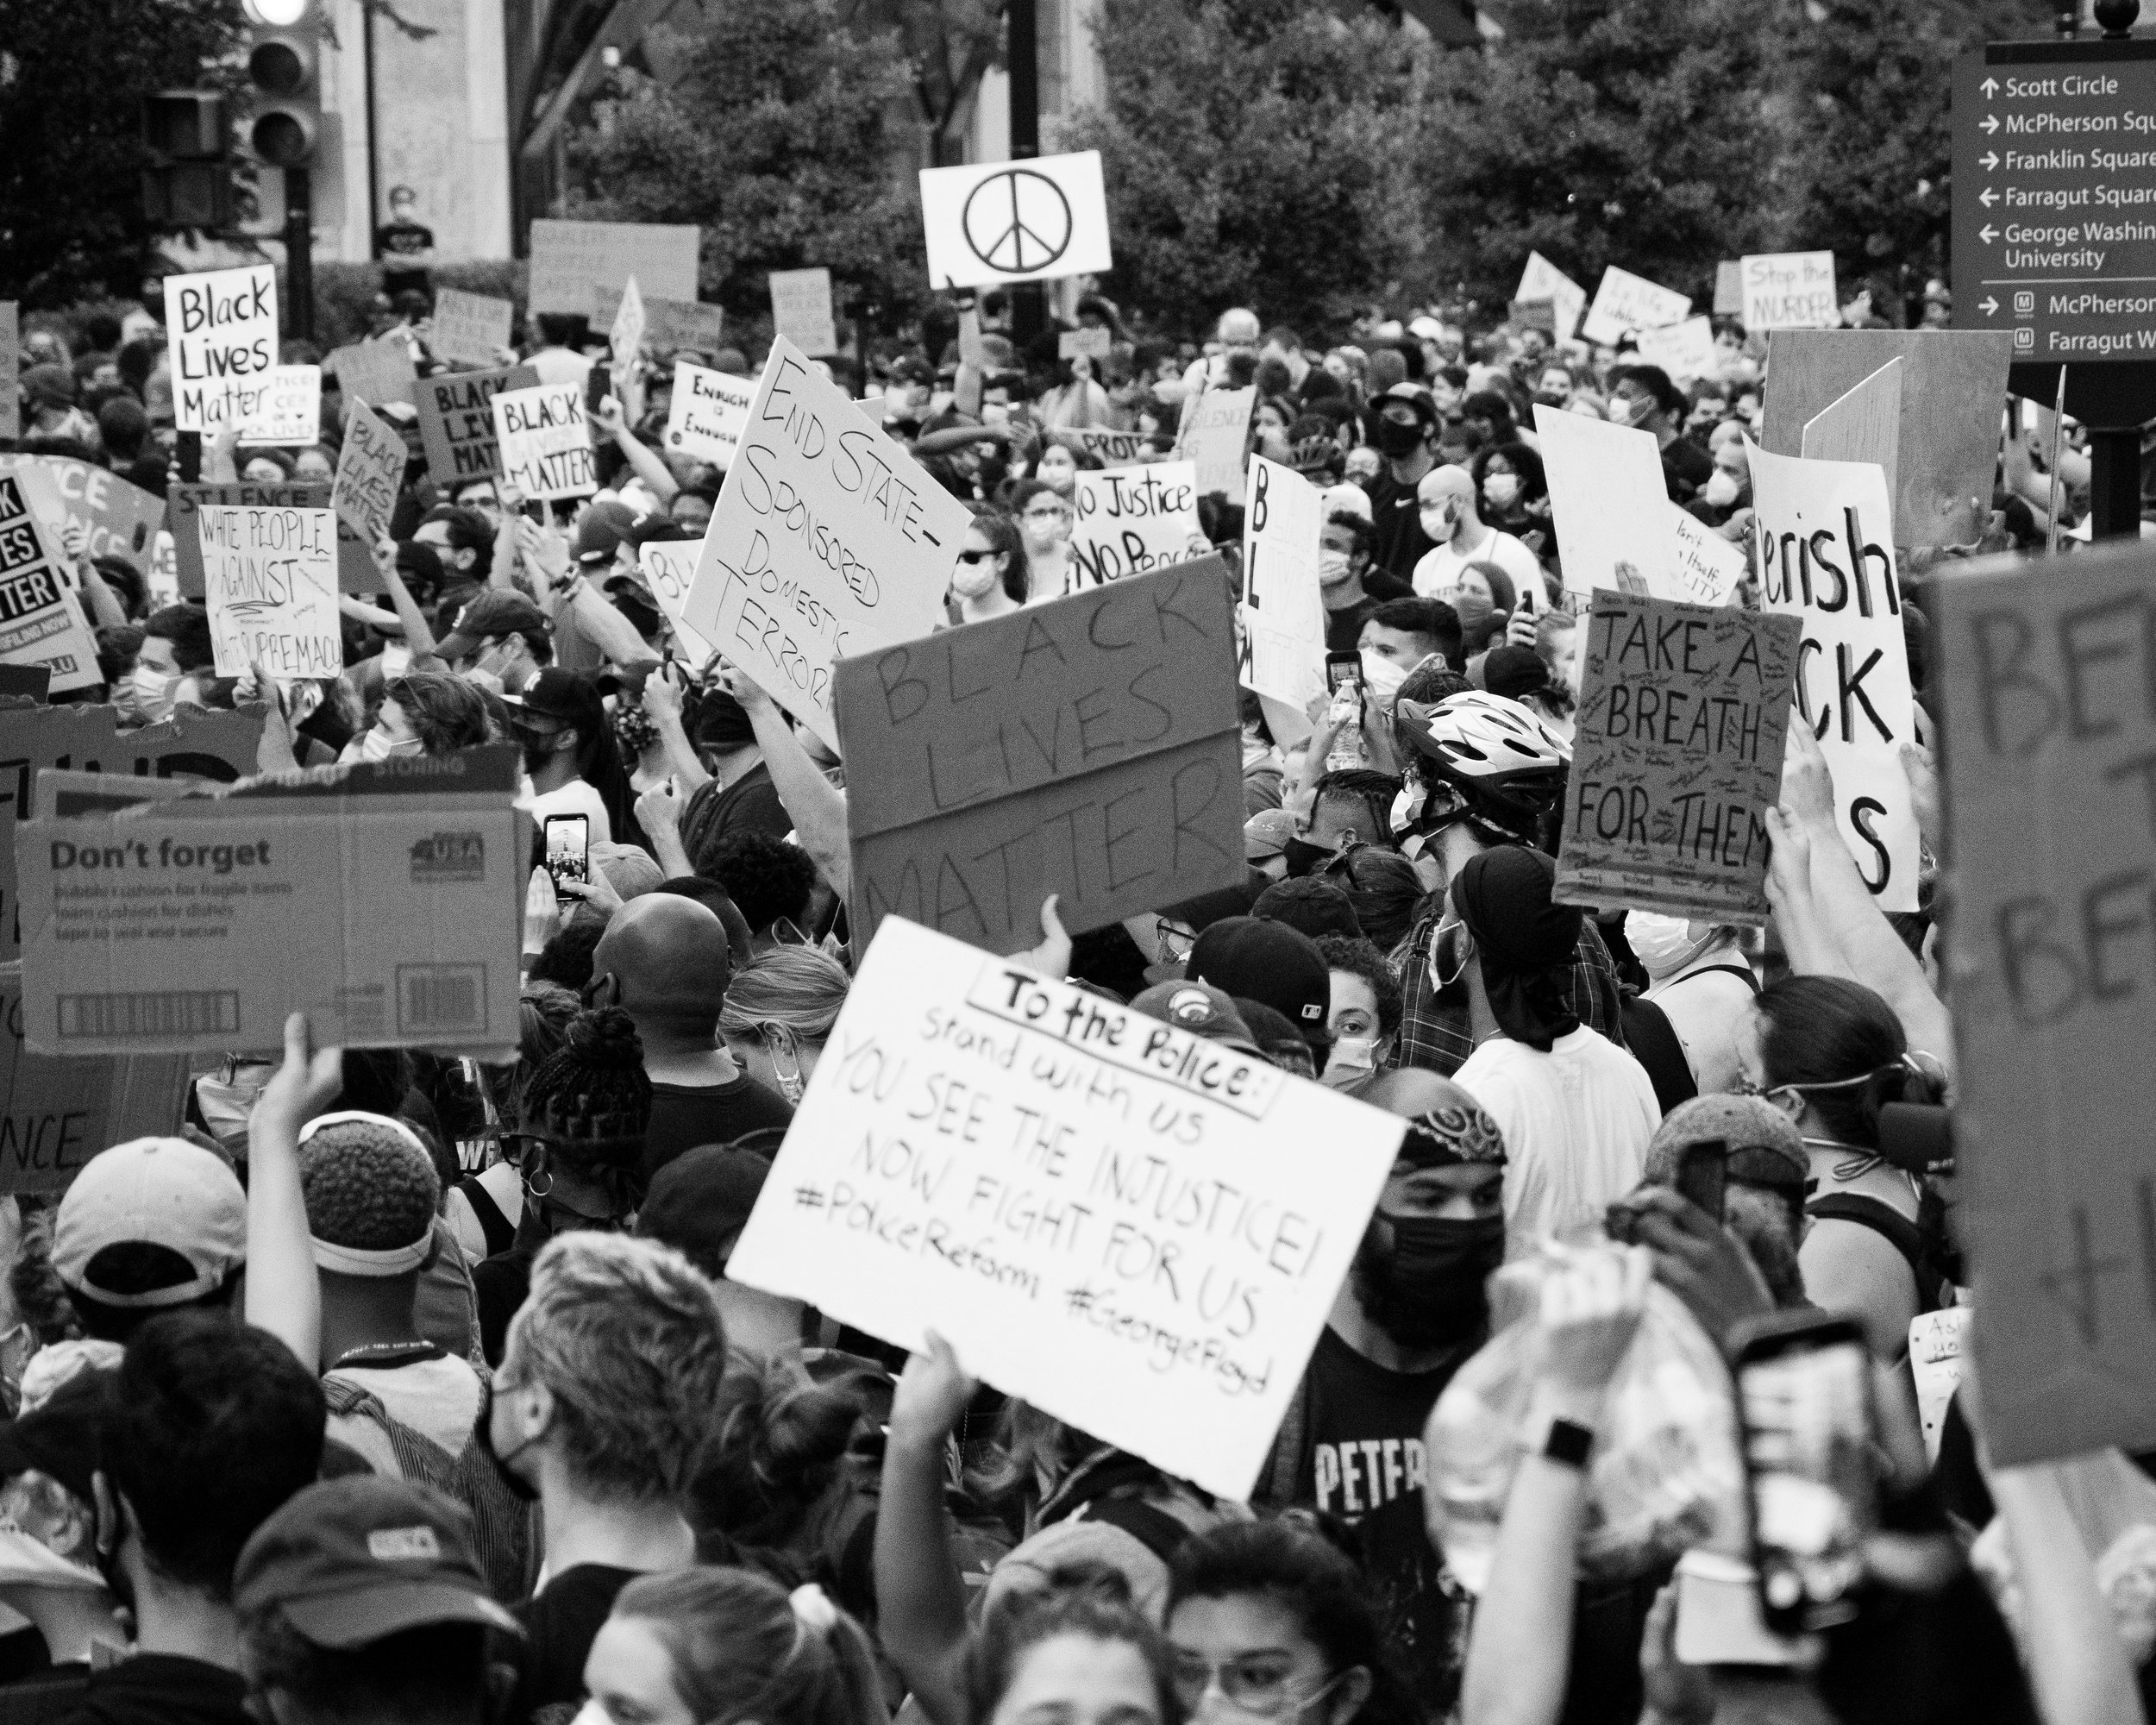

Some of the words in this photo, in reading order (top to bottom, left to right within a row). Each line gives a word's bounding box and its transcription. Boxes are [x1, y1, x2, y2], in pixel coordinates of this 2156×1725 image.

[2006, 77, 2057, 97] Scott
[2062, 73, 2119, 96] Circle
[2006, 112, 2117, 134] McPherson
[2123, 110, 2156, 135] Squ
[2006, 148, 2085, 171] Franklin
[2006, 185, 2090, 210] Farragut
[2005, 223, 2079, 247] George
[2083, 220, 2156, 242] Washin
[2005, 247, 2105, 272] University
[179, 275, 271, 334] Black
[181, 337, 270, 380] Lives
[2049, 330, 2133, 354] Farragut
[183, 381, 271, 429] Matter
[443, 411, 495, 442] LIV
[505, 393, 583, 433] BLACK
[762, 355, 825, 459] END
[454, 442, 500, 474] MAT
[507, 447, 595, 491] MATTER
[178, 488, 308, 514] SILENCE
[1103, 469, 1193, 518] Justice
[248, 510, 331, 555] PEOPLE
[740, 445, 880, 607] SPONSORED
[218, 556, 298, 604] AGAINST
[1762, 505, 1899, 618] erish
[740, 529, 849, 656] DOMESTIC
[714, 559, 834, 712] TERROR
[877, 578, 1209, 726] BLACK
[1595, 610, 1708, 674] TAKE
[1729, 632, 1763, 685] A
[925, 662, 1173, 811] LIVES
[1606, 684, 1764, 763] BREATH
[868, 757, 1232, 936] MATTER
[1576, 781, 1651, 846] FOR
[1672, 792, 1771, 869] THEM
[50, 838, 149, 871] Don't
[159, 837, 272, 874] forget
[1001, 969, 1051, 1024] To
[1062, 987, 1131, 1050] the
[829, 1032, 906, 1103] YOU
[906, 1072, 993, 1145] SEE
[1010, 1104, 1078, 1180] THE
[1031, 1050, 1132, 1119] with
[860, 1127, 952, 1206] NOW
[972, 1174, 1097, 1257] FIGHT
[1101, 1223, 1183, 1302] FOR
[1198, 1264, 1260, 1340] US
